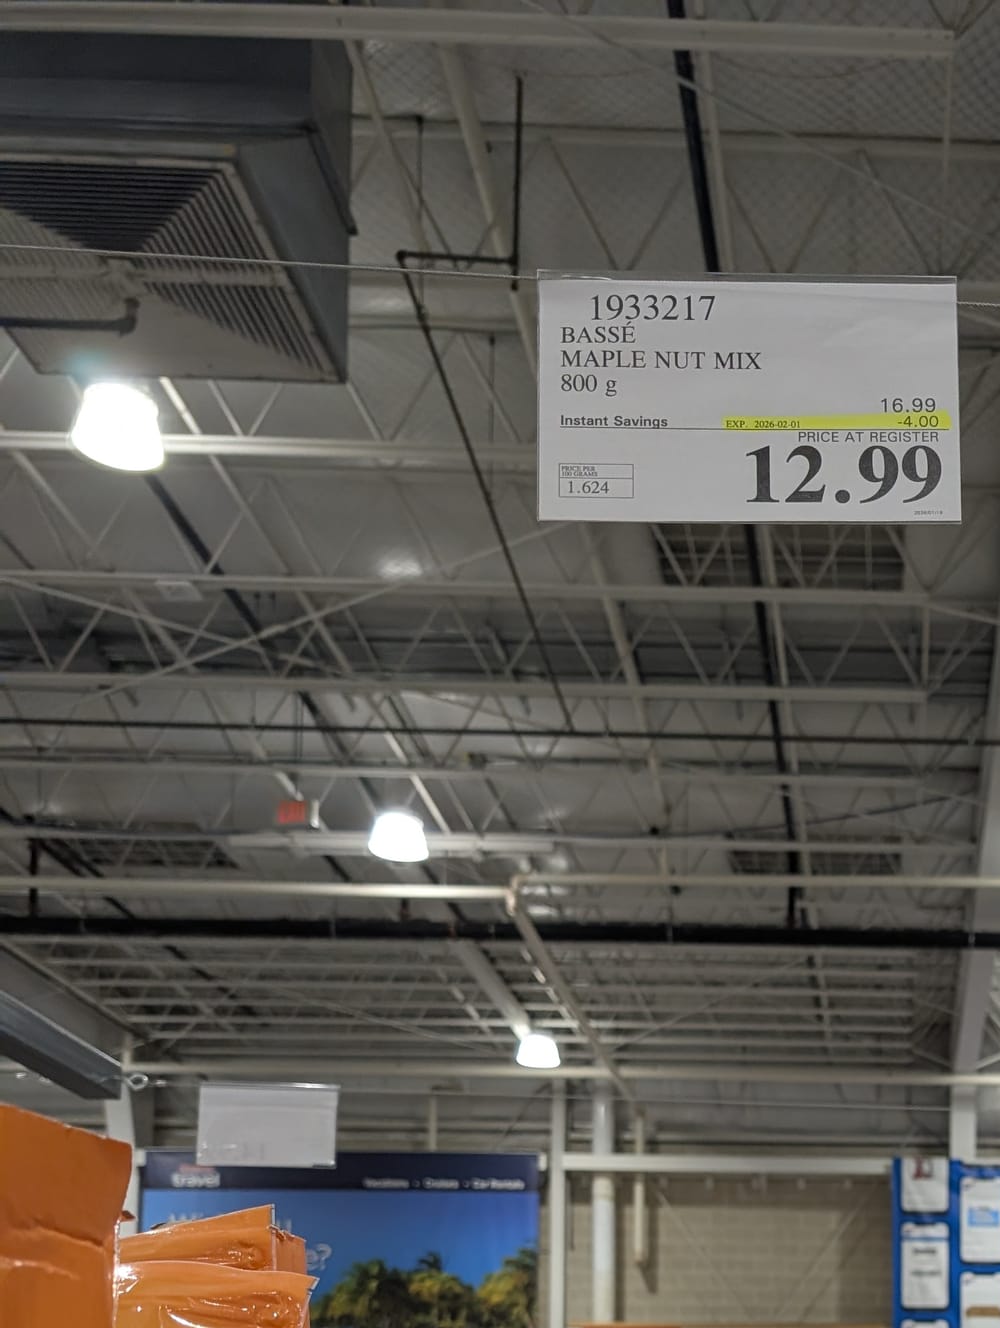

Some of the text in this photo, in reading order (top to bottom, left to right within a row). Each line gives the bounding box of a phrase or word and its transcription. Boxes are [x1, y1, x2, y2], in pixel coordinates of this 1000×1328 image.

[590, 295, 716, 321] 1933217
[560, 322, 636, 344] BASSÉ
[560, 350, 762, 371] MAPLE NUT MIX
[560, 374, 618, 397] 800 g
[880, 398, 937, 414] 16.99
[560, 414, 669, 429] Instant Savings
[726, 419, 801, 429] EXP. 2026-02-01
[897, 414, 940, 429] -4.00
[798, 431, 940, 443] PRICE AT REGISTER
[745, 445, 942, 504] 12.99
[568, 480, 610, 494] 1.624
